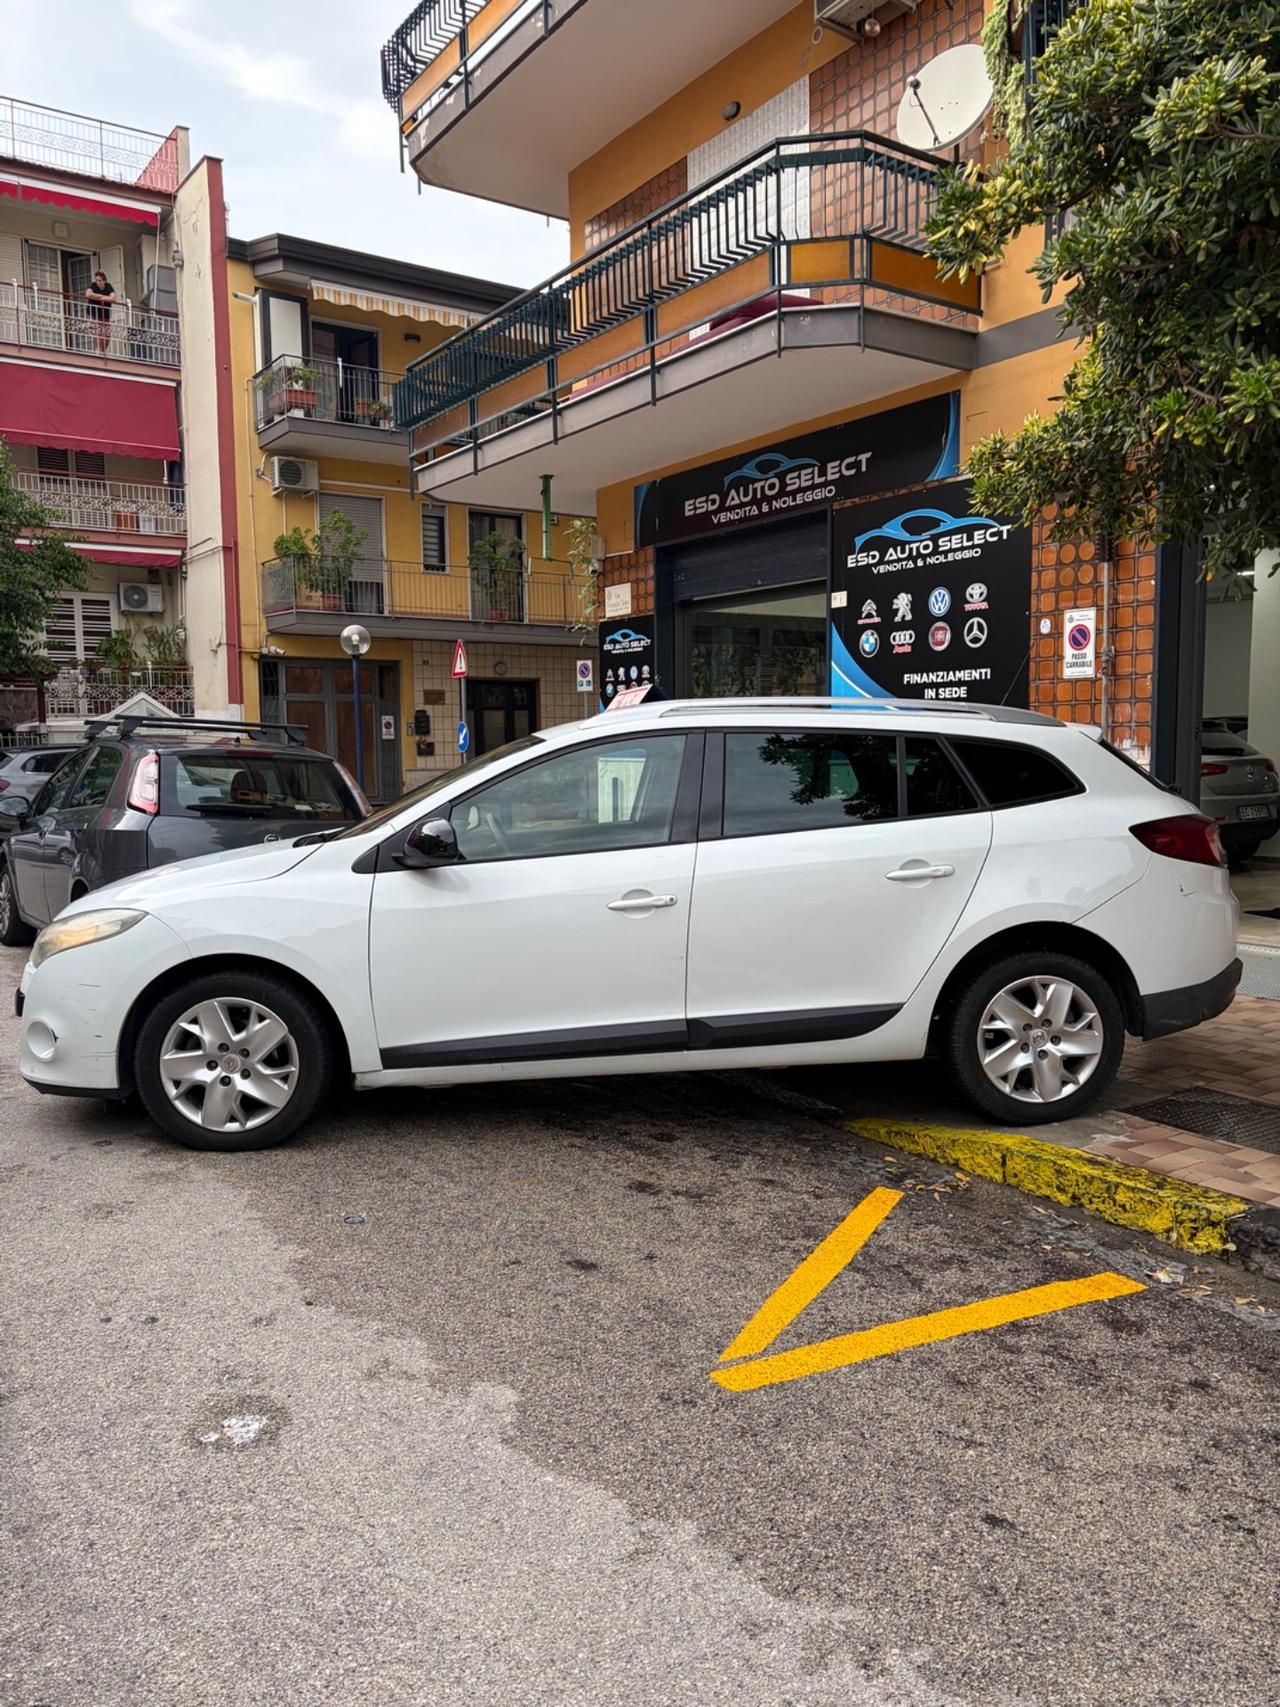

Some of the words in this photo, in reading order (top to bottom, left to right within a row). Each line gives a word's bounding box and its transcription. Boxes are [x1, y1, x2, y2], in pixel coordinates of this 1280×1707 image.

[684, 493, 720, 516] ESD
[725, 477, 780, 507] AUTO
[785, 452, 873, 492] SELECT
[711, 505, 759, 524] VENDITA
[761, 502, 769, 512] &
[772, 485, 836, 511] NOLEGGIO
[847, 551, 880, 568] ESD
[884, 540, 933, 562] AUTO
[938, 525, 1012, 551] SELECT
[872, 561, 915, 574] VENDITA
[917, 557, 924, 567] &
[926, 548, 982, 565] NOLEGGIO
[903, 668, 991, 684] FINANZIAMENTI
[1066, 660, 1092, 669] CARRABILE
[924, 688, 936, 699] IN
[938, 687, 967, 698] SEDE
